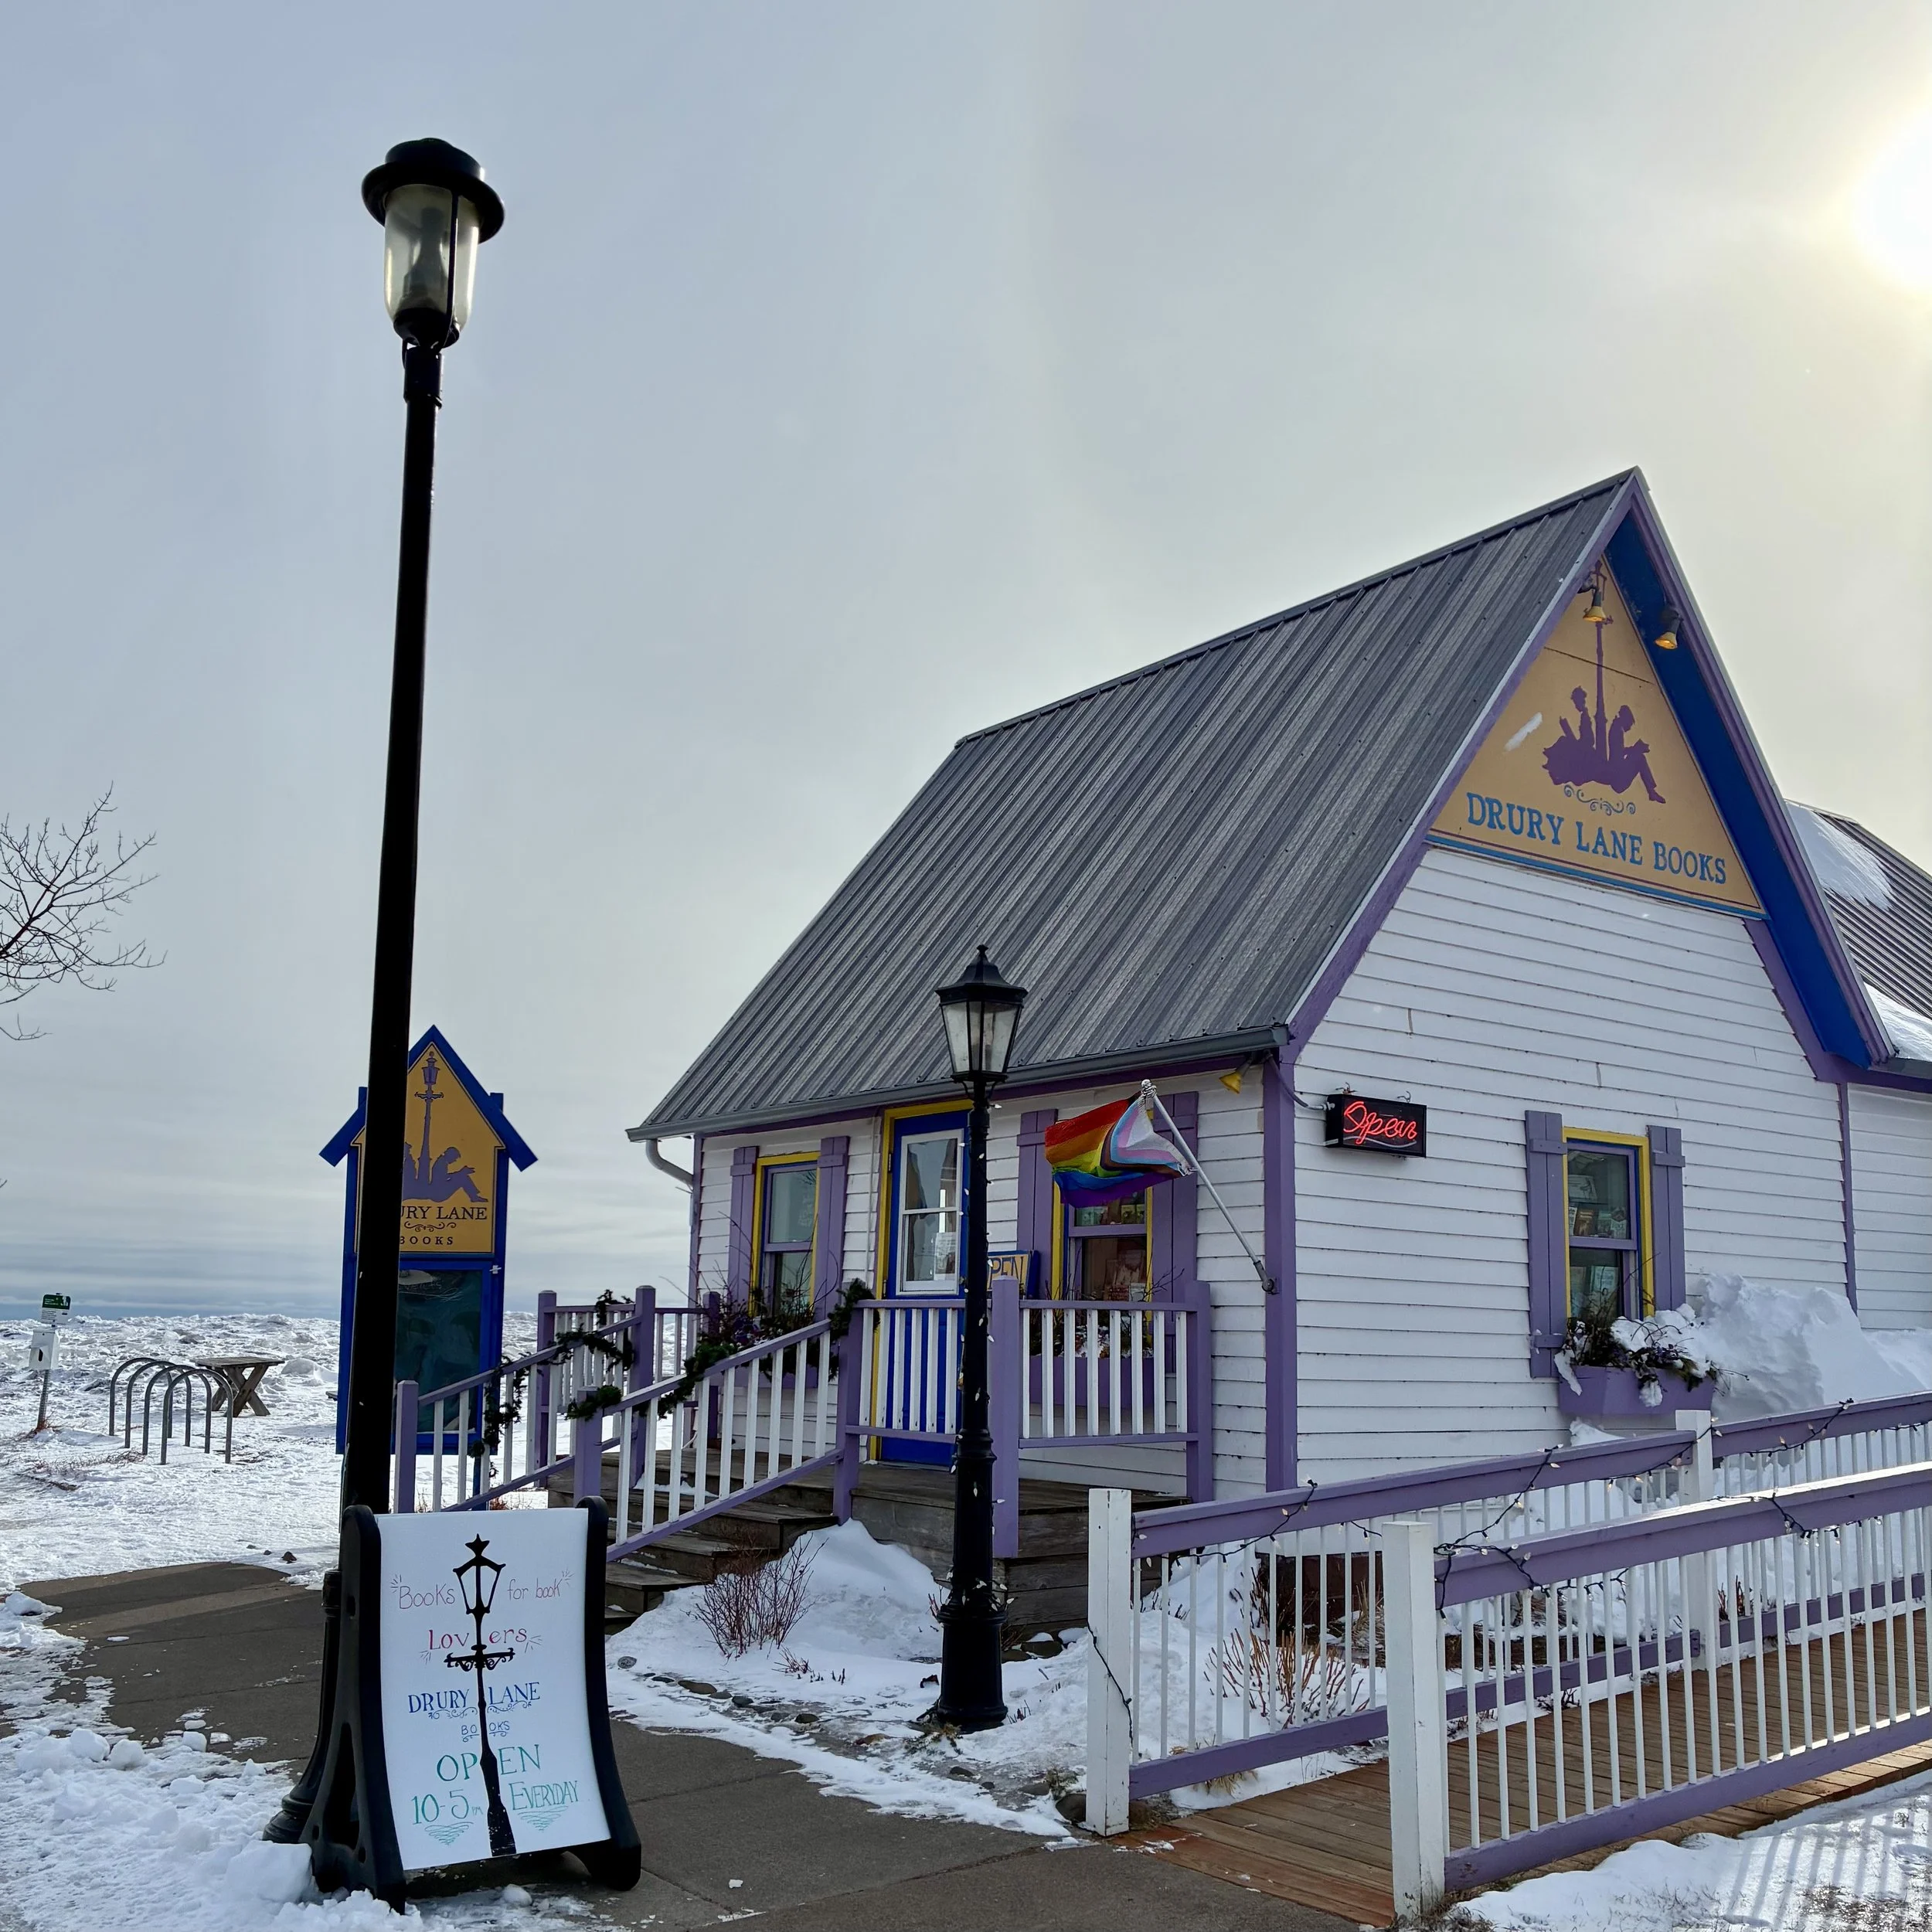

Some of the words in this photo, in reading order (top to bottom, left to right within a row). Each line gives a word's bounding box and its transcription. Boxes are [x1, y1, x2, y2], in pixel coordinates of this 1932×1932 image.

[1466, 792, 1564, 845] DRURY
[1576, 821, 1643, 864] LANE
[1654, 841, 1727, 885] BOOKS
[1343, 1101, 1417, 1145] Open
[436, 1206, 487, 1220] LANE
[988, 1255, 1025, 1290] PEN
[507, 1579, 529, 1600] for
[536, 1578, 563, 1599] book
[408, 1689, 469, 1713] DRURY
[488, 1682, 540, 1705] LANE
